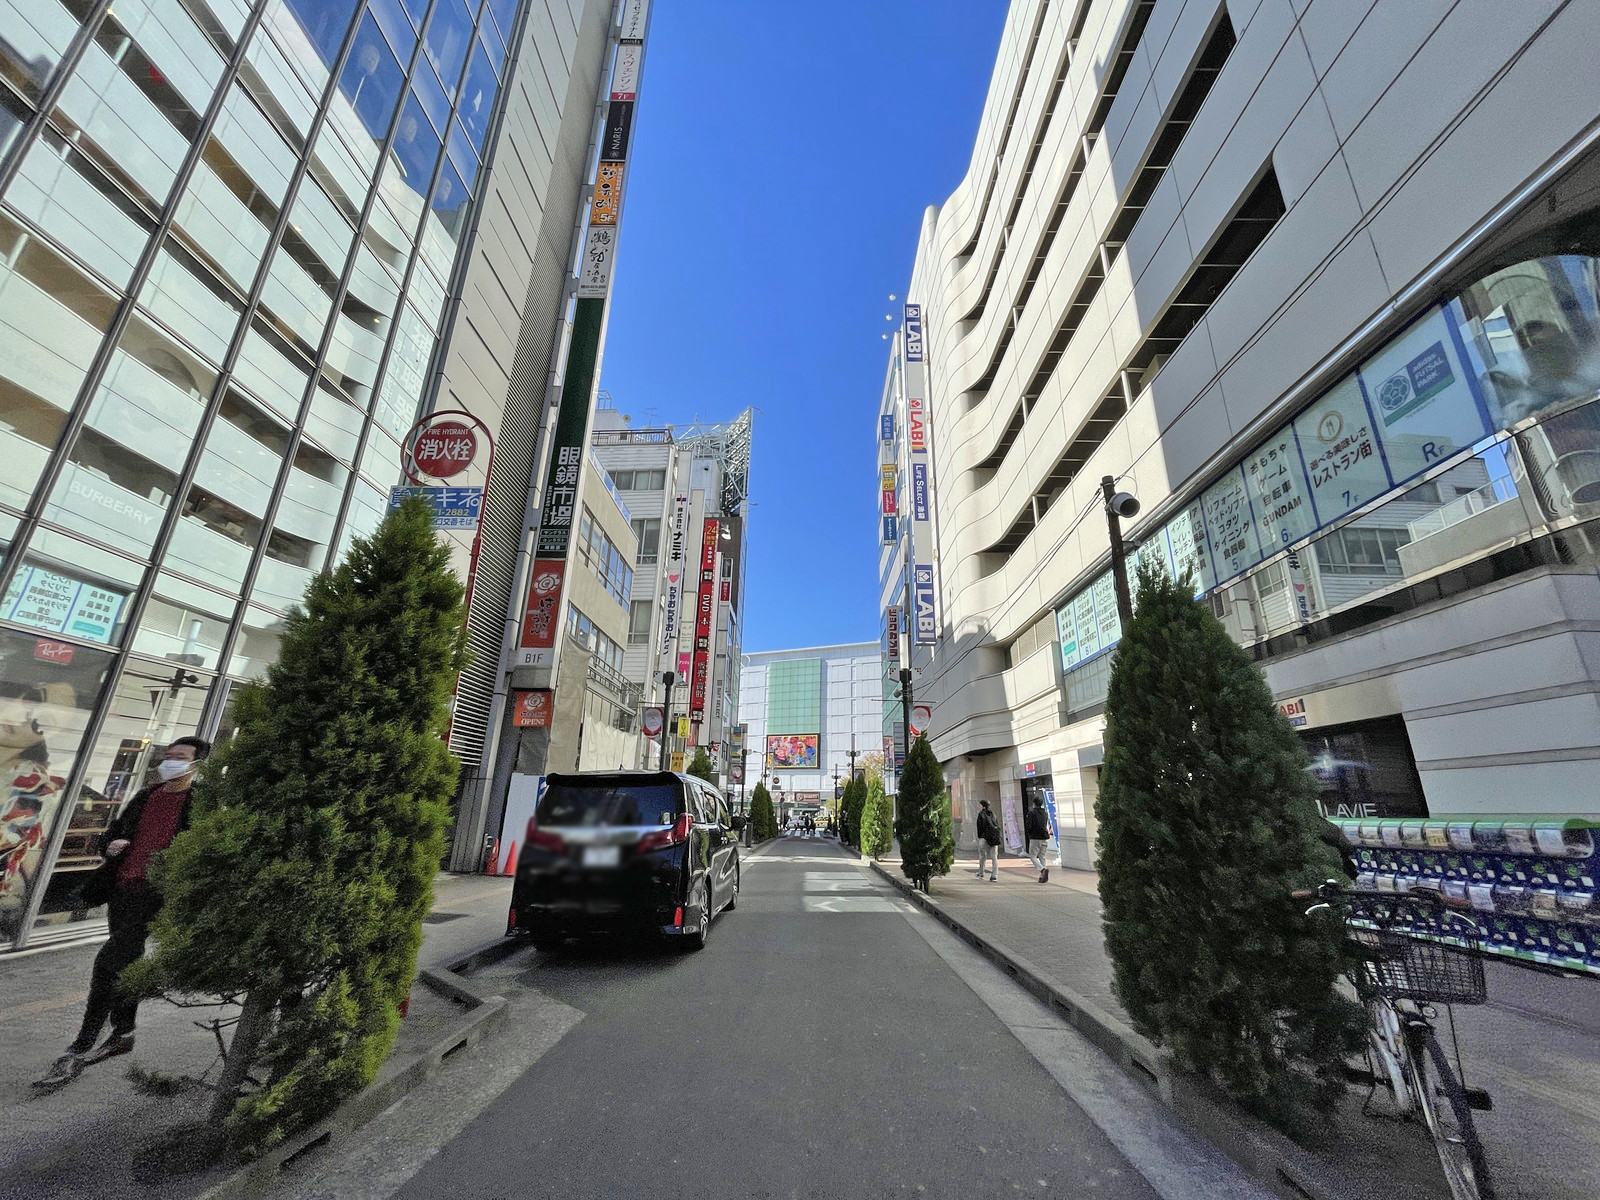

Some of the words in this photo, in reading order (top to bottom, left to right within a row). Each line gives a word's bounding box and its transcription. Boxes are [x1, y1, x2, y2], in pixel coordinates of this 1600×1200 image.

[612, 127, 623, 150] NARIS
[906, 321, 922, 360] LABI
[1415, 357, 1444, 379] FUTSAL
[1417, 371, 1438, 388] PARK
[911, 411, 925, 446] LABI
[418, 438, 473, 461] 消火栓
[1249, 443, 1288, 475] おもちゃ
[1259, 464, 1288, 489] ゲーム
[1313, 439, 1373, 489] レストラン街
[549, 446, 581, 526] 眼鏡市場
[1207, 485, 1243, 515] リフォーム
[1262, 480, 1292, 507] 自転車
[70, 481, 155, 525] BURBERRY
[1262, 495, 1302, 527] GUNDAM
[1218, 514, 1239, 534] コタツ
[917, 588, 936, 640] LABI
[524, 653, 544, 664] B1F
[1324, 803, 1378, 818] LAVIE
